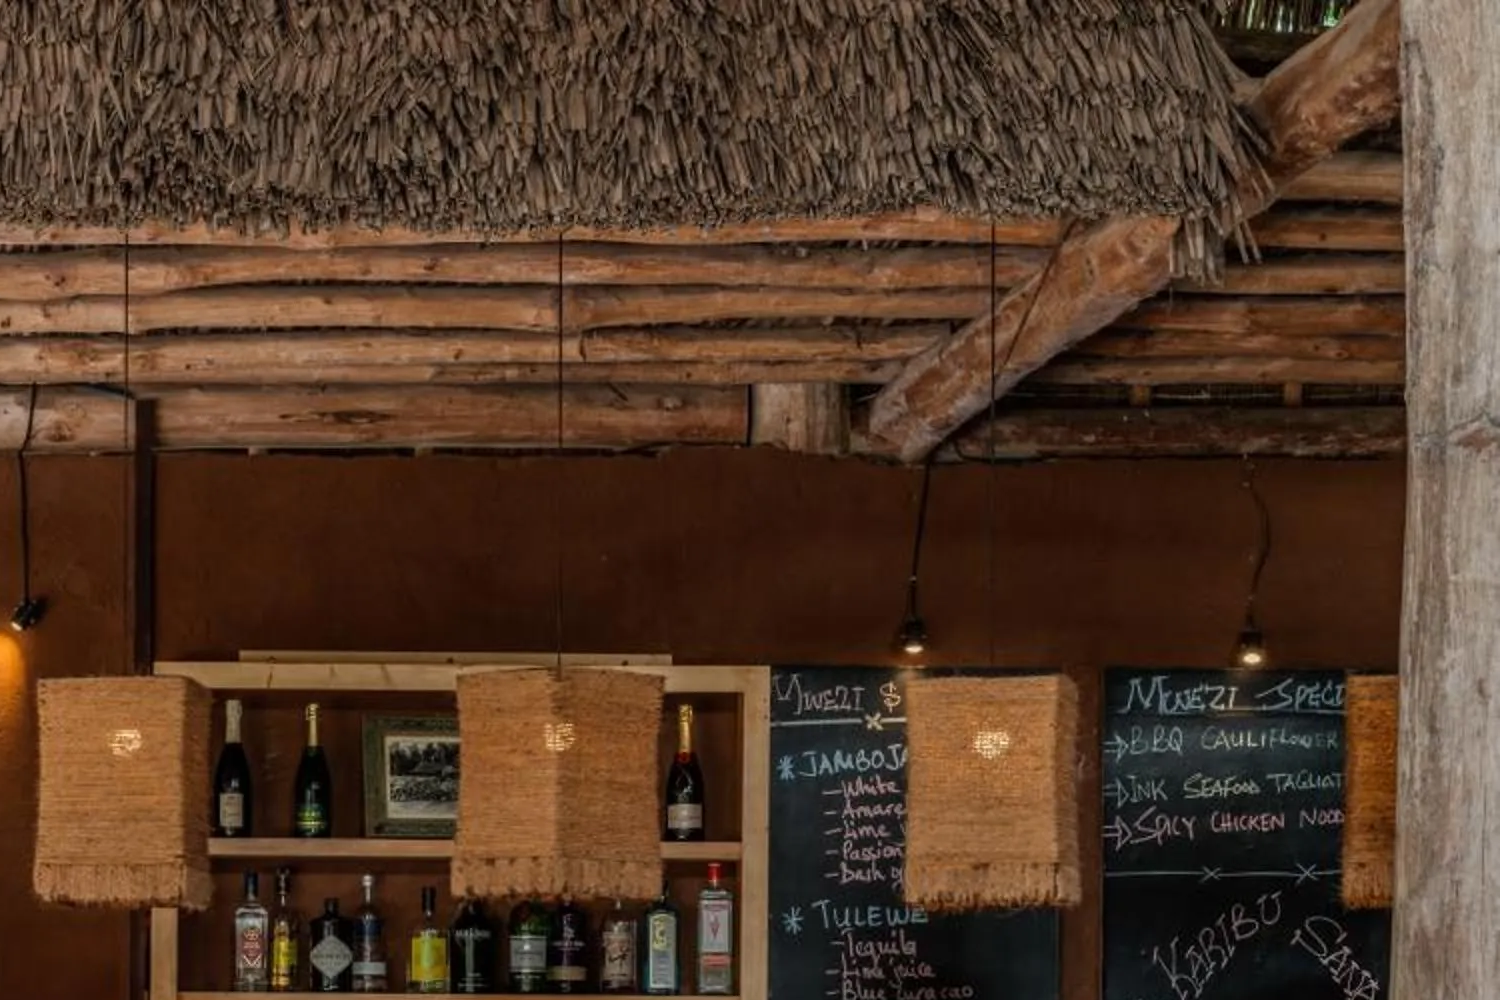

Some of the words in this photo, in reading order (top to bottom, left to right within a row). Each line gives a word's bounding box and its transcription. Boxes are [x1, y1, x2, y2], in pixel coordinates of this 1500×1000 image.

[1129, 725, 1184, 756] BBQ
[1201, 725, 1339, 751] CAULIFLOWER
[841, 774, 903, 800] White
[1127, 774, 1169, 803] INK
[1183, 772, 1261, 799] SEAFOOD
[842, 819, 892, 840] Lime
[1130, 805, 1198, 845] SPICY
[1211, 811, 1286, 833] CHICKEN
[811, 900, 929, 929] TULEWE
[841, 927, 918, 966] Tequila
[841, 952, 886, 979] Lime
[889, 957, 937, 989] juice
